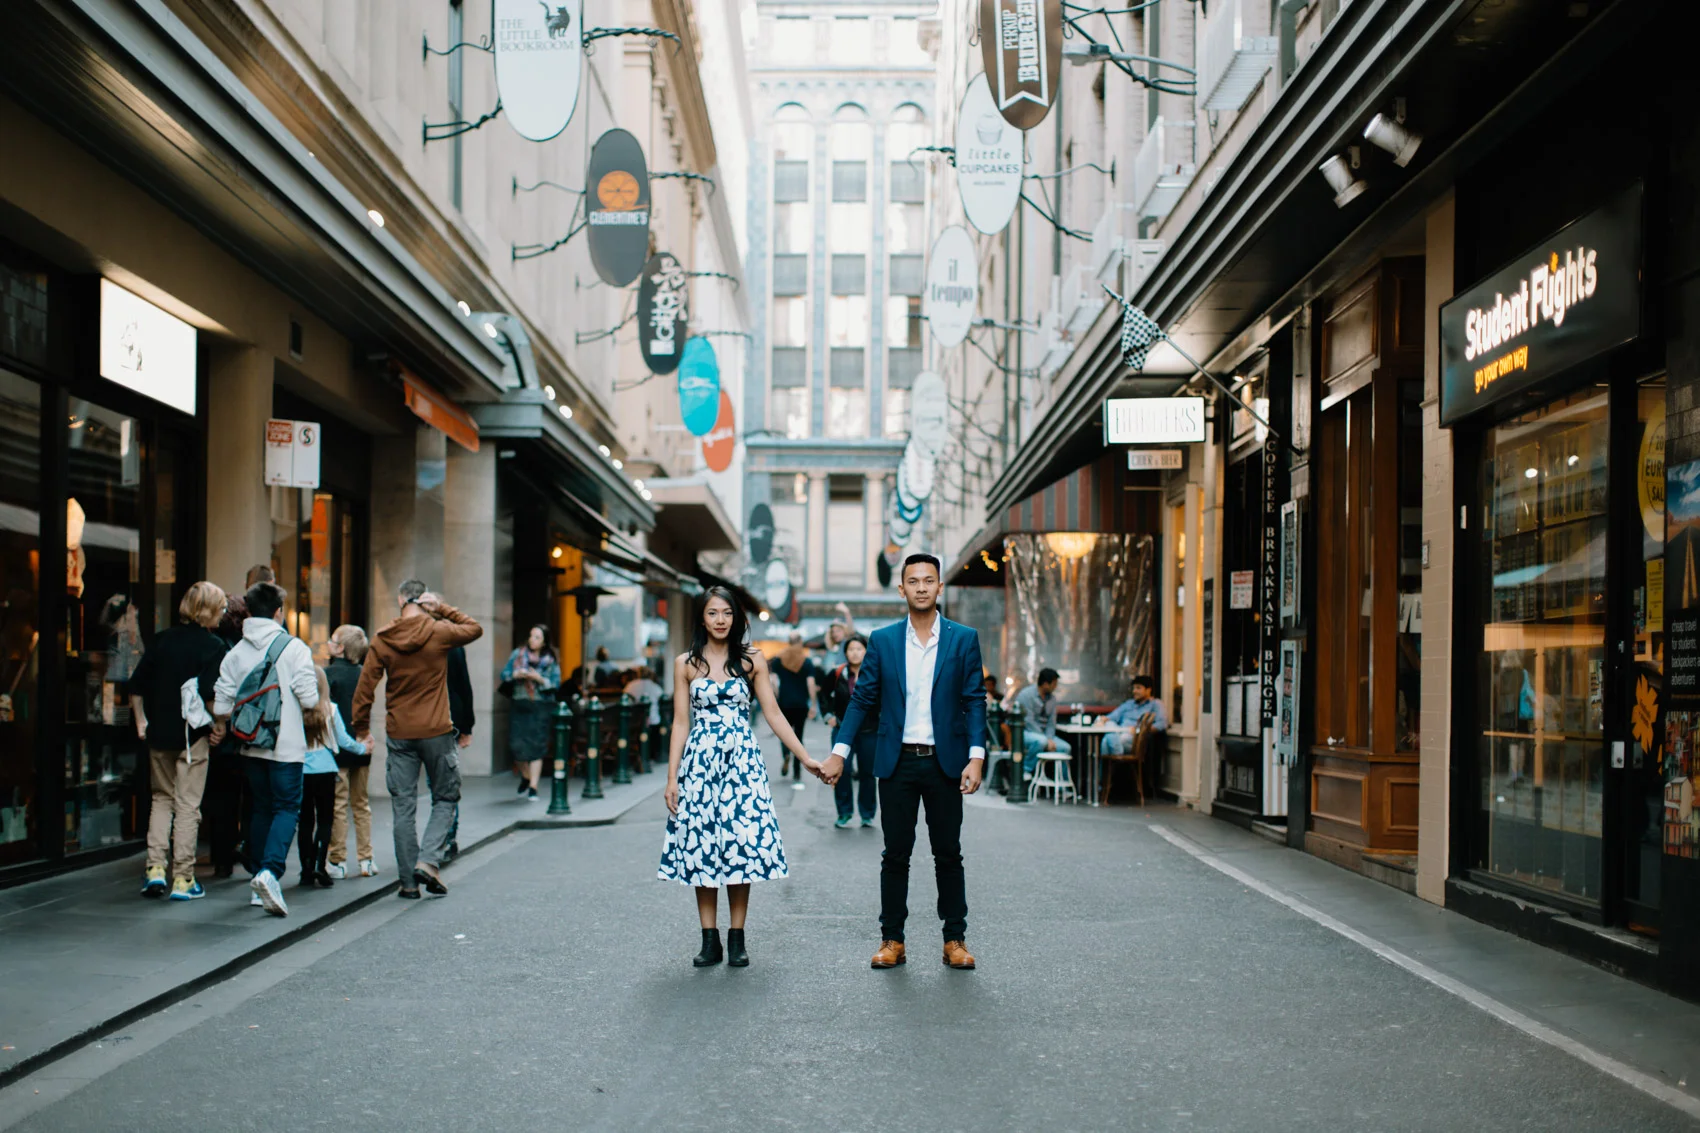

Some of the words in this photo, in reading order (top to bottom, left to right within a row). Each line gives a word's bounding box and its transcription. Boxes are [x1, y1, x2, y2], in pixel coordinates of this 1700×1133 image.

[500, 18, 525, 30] THE
[1002, 10, 1019, 50] PERKUP
[500, 30, 541, 40] LITTLE
[1017, 0, 1039, 82] BURGE
[500, 40, 575, 52] BOOKROOM
[960, 163, 1020, 174] CUPCAKES
[1465, 291, 1529, 362] Student
[1530, 246, 1598, 327] Flights
[1474, 368, 1484, 395] go
[1484, 359, 1499, 390] your
[1499, 352, 1514, 377] own
[1513, 345, 1529, 371] way
[1265, 440, 1276, 513] COFFEE
[1651, 485, 1665, 502] SAL
[1264, 526, 1275, 636] BREAKFAST
[1684, 618, 1697, 632] travel
[1671, 672, 1695, 686] adventurers
